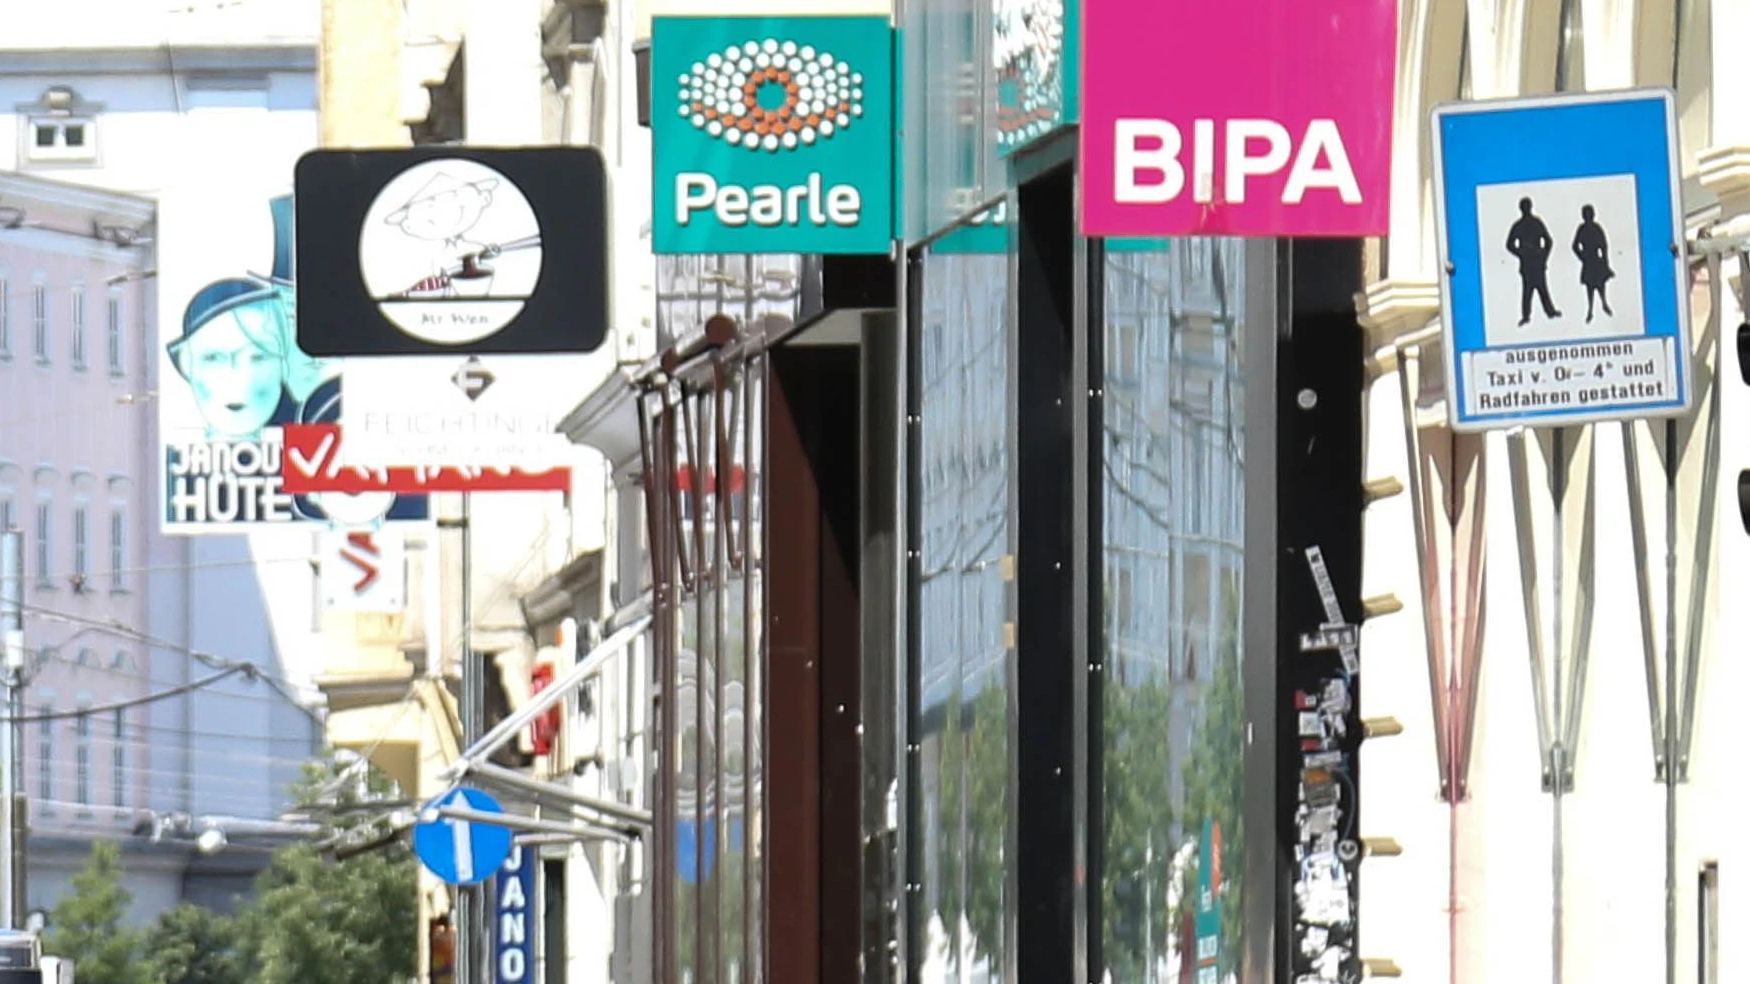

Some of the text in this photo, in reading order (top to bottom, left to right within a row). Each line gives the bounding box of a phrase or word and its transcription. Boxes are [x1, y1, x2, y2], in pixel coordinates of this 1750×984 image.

[1113, 118, 1363, 204] BIPA
[675, 173, 861, 226] Pearle
[1505, 343, 1633, 364] ausgenommen
[1487, 370, 1523, 387] Taxi
[1623, 359, 1655, 377] und
[1479, 381, 1663, 410] Radfahren gestattet
[171, 441, 282, 474] JANOU
[172, 473, 293, 522] HÜTE
